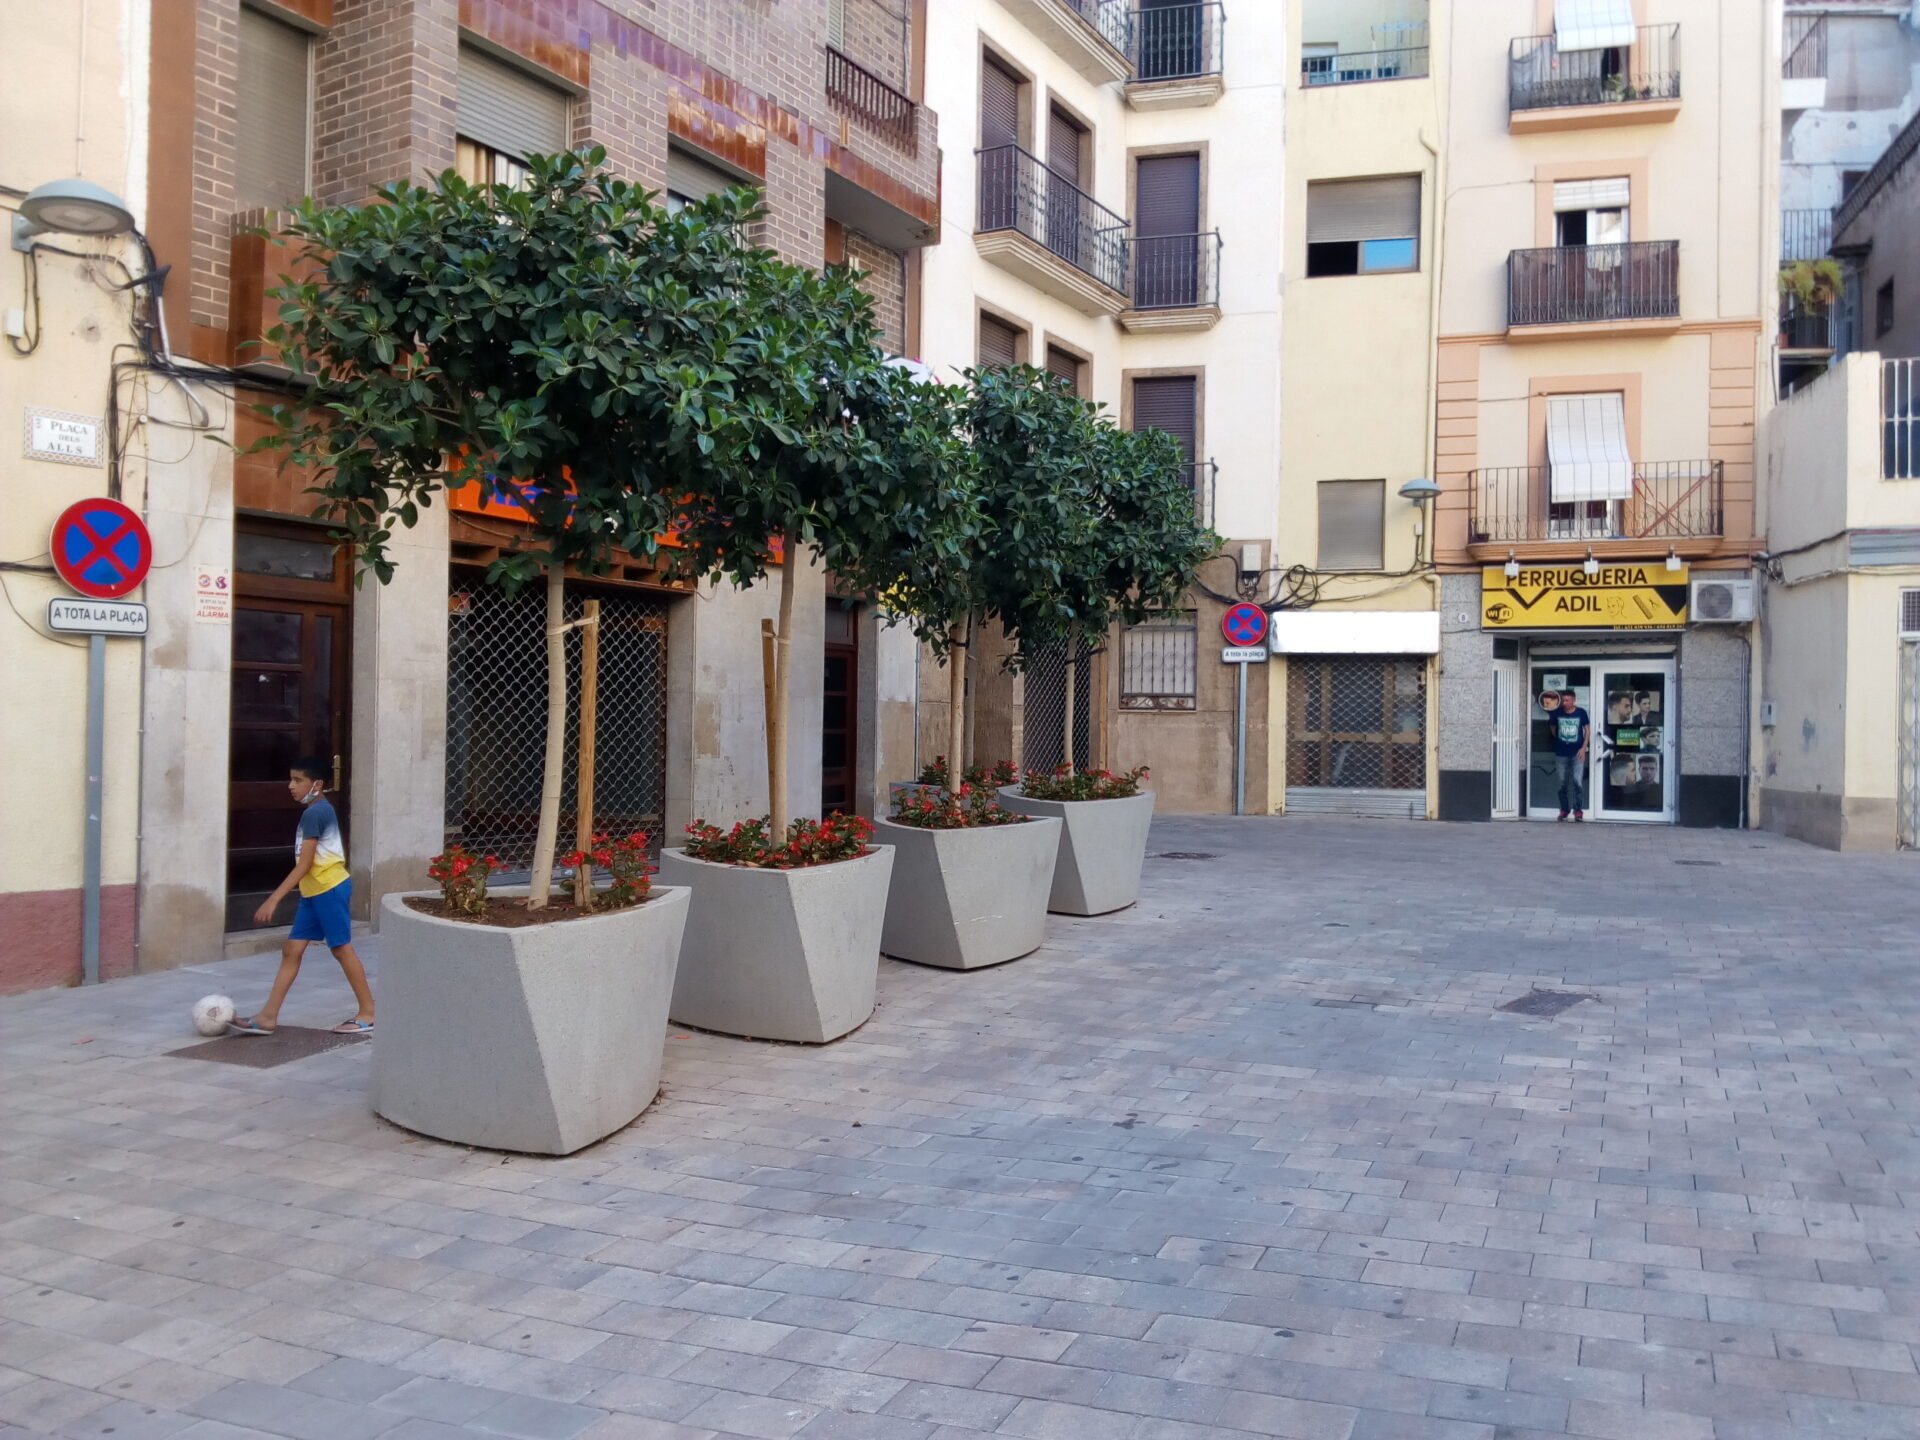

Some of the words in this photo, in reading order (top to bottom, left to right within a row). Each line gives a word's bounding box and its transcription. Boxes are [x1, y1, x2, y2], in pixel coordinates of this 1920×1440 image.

[47, 442, 83, 454] ALLS
[1506, 568, 1648, 587] PERRUQUERIA
[1554, 595, 1602, 612] ADIL
[53, 607, 62, 619] A
[64, 607, 91, 620] TOTA
[93, 609, 107, 621] LA
[109, 610, 144, 626] PLAÇA
[196, 610, 229, 618] ALARMA
